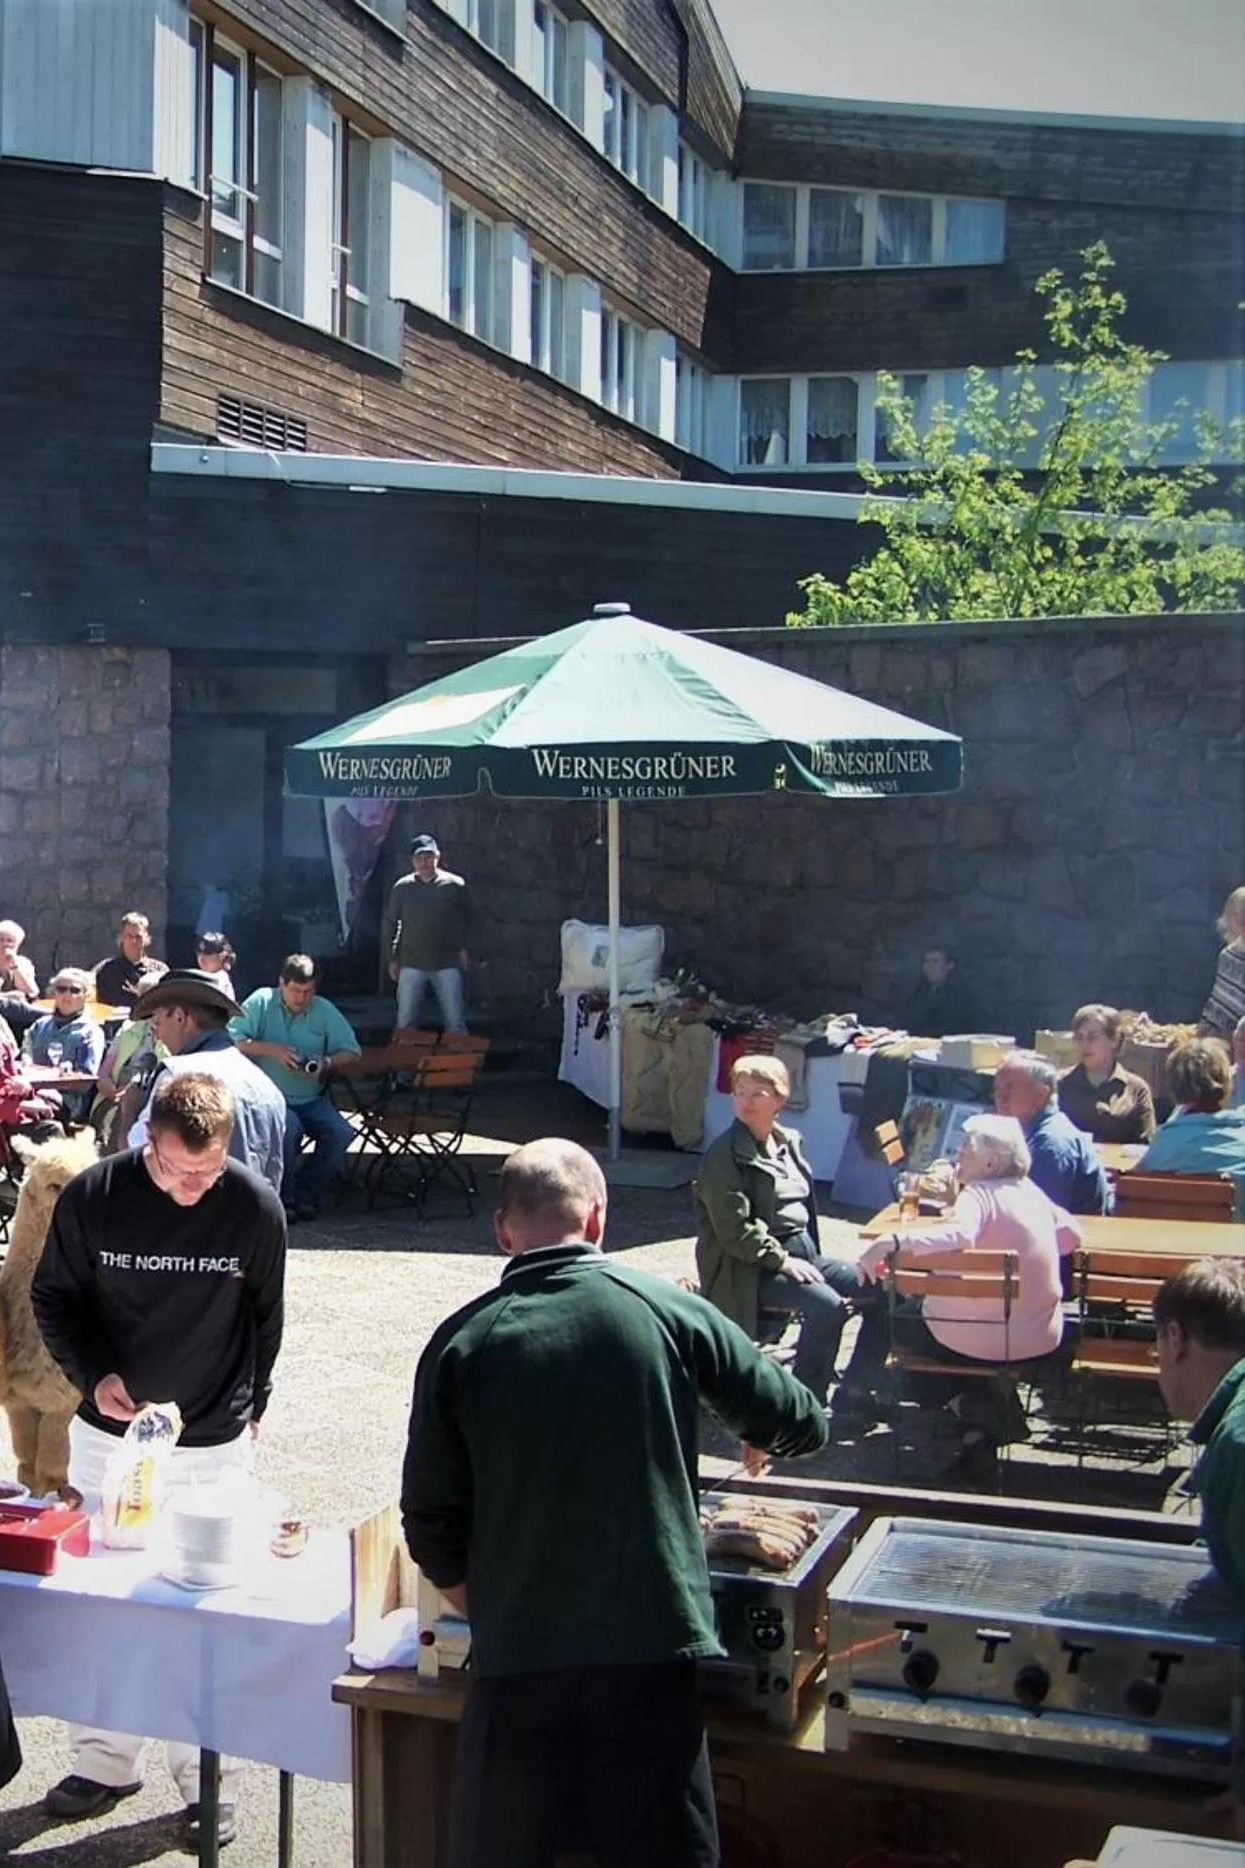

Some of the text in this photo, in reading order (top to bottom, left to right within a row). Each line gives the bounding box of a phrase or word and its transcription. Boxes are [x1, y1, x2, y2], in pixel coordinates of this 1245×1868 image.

[532, 749, 737, 780] WERNESGRÜNER
[582, 786, 685, 798] PILS LEGENDE
[100, 1251, 240, 1273] THE NORTH FACE
